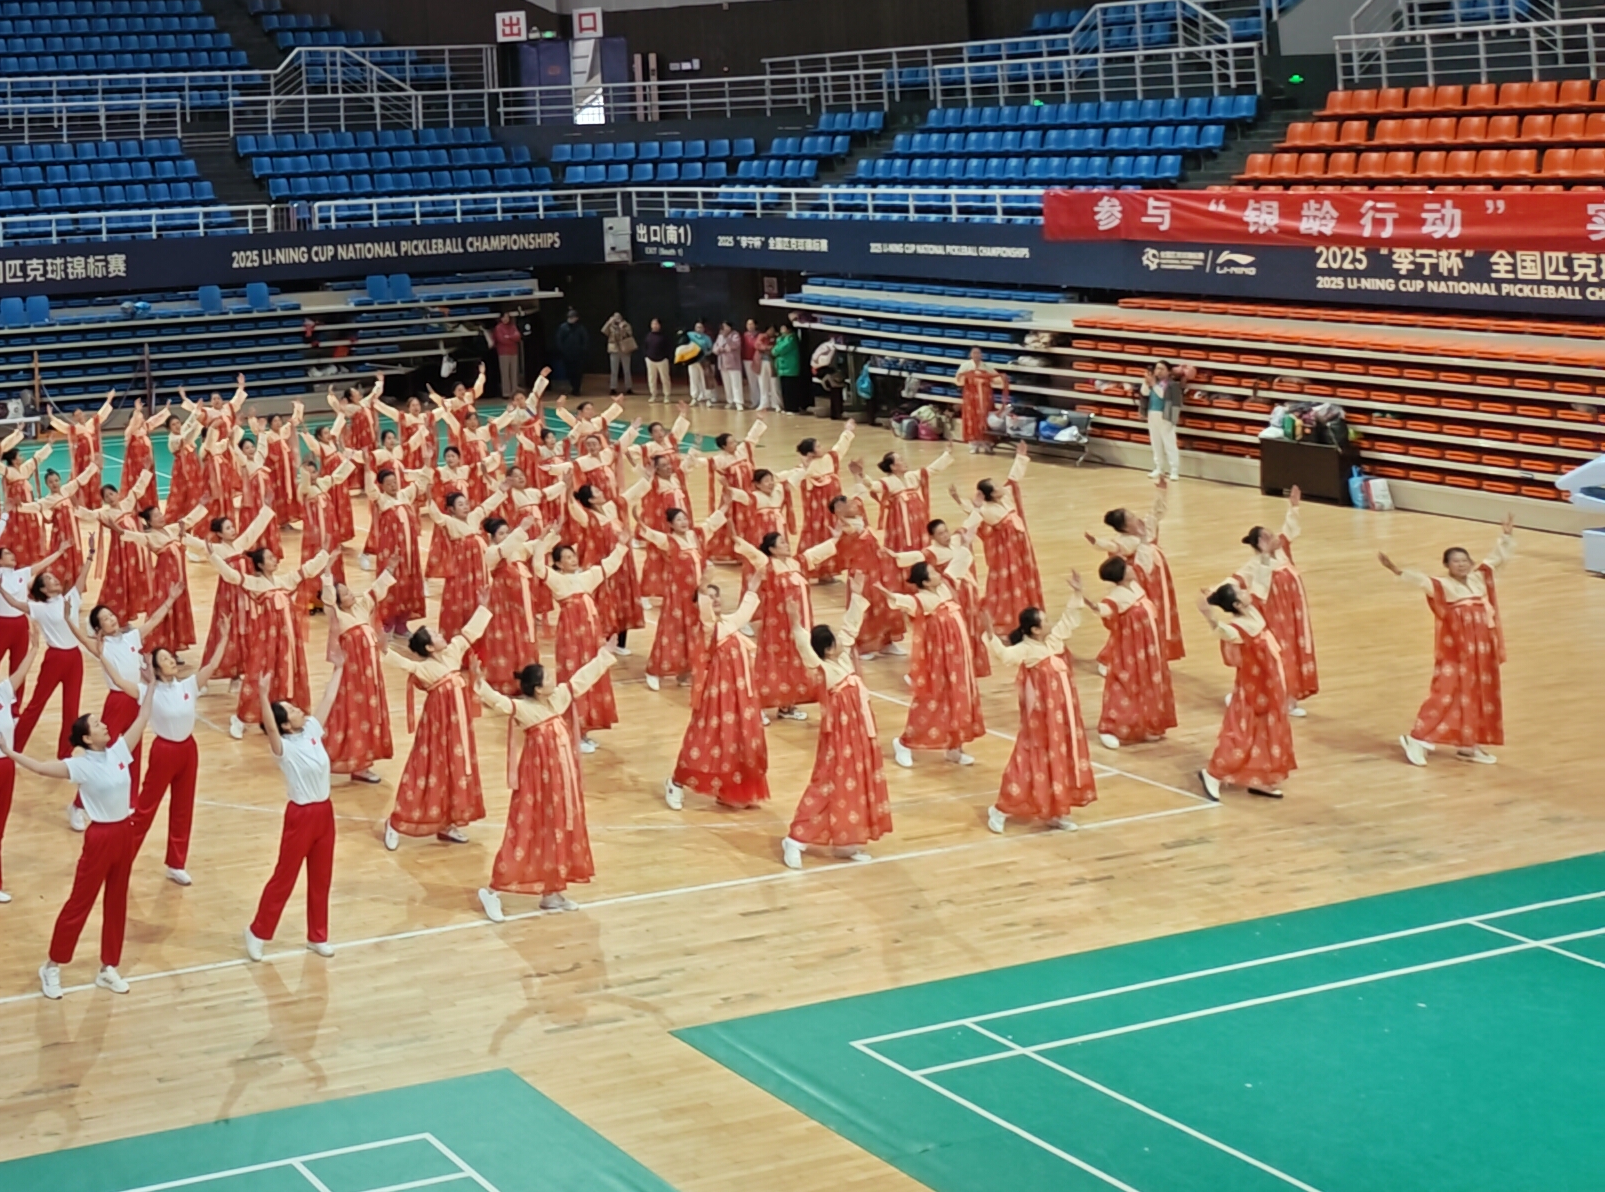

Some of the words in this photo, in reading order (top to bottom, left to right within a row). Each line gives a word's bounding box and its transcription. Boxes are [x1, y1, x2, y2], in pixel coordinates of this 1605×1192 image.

[231, 250, 260, 268] 2025
[262, 247, 309, 266] LI-NING
[311, 245, 335, 263] CUP
[337, 242, 399, 261] NATIONAL
[400, 237, 465, 257] PICKLEBALL
[466, 232, 561, 253] CHAMPIONSHIPS
[1315, 245, 1368, 270] 2025
[1316, 275, 1345, 289] 2025
[1347, 277, 1396, 292] LI-NING
[1398, 279, 1425, 294] CUP
[1427, 280, 1499, 297] NATIONAL
[1501, 283, 1583, 300] PICKLEBALL
